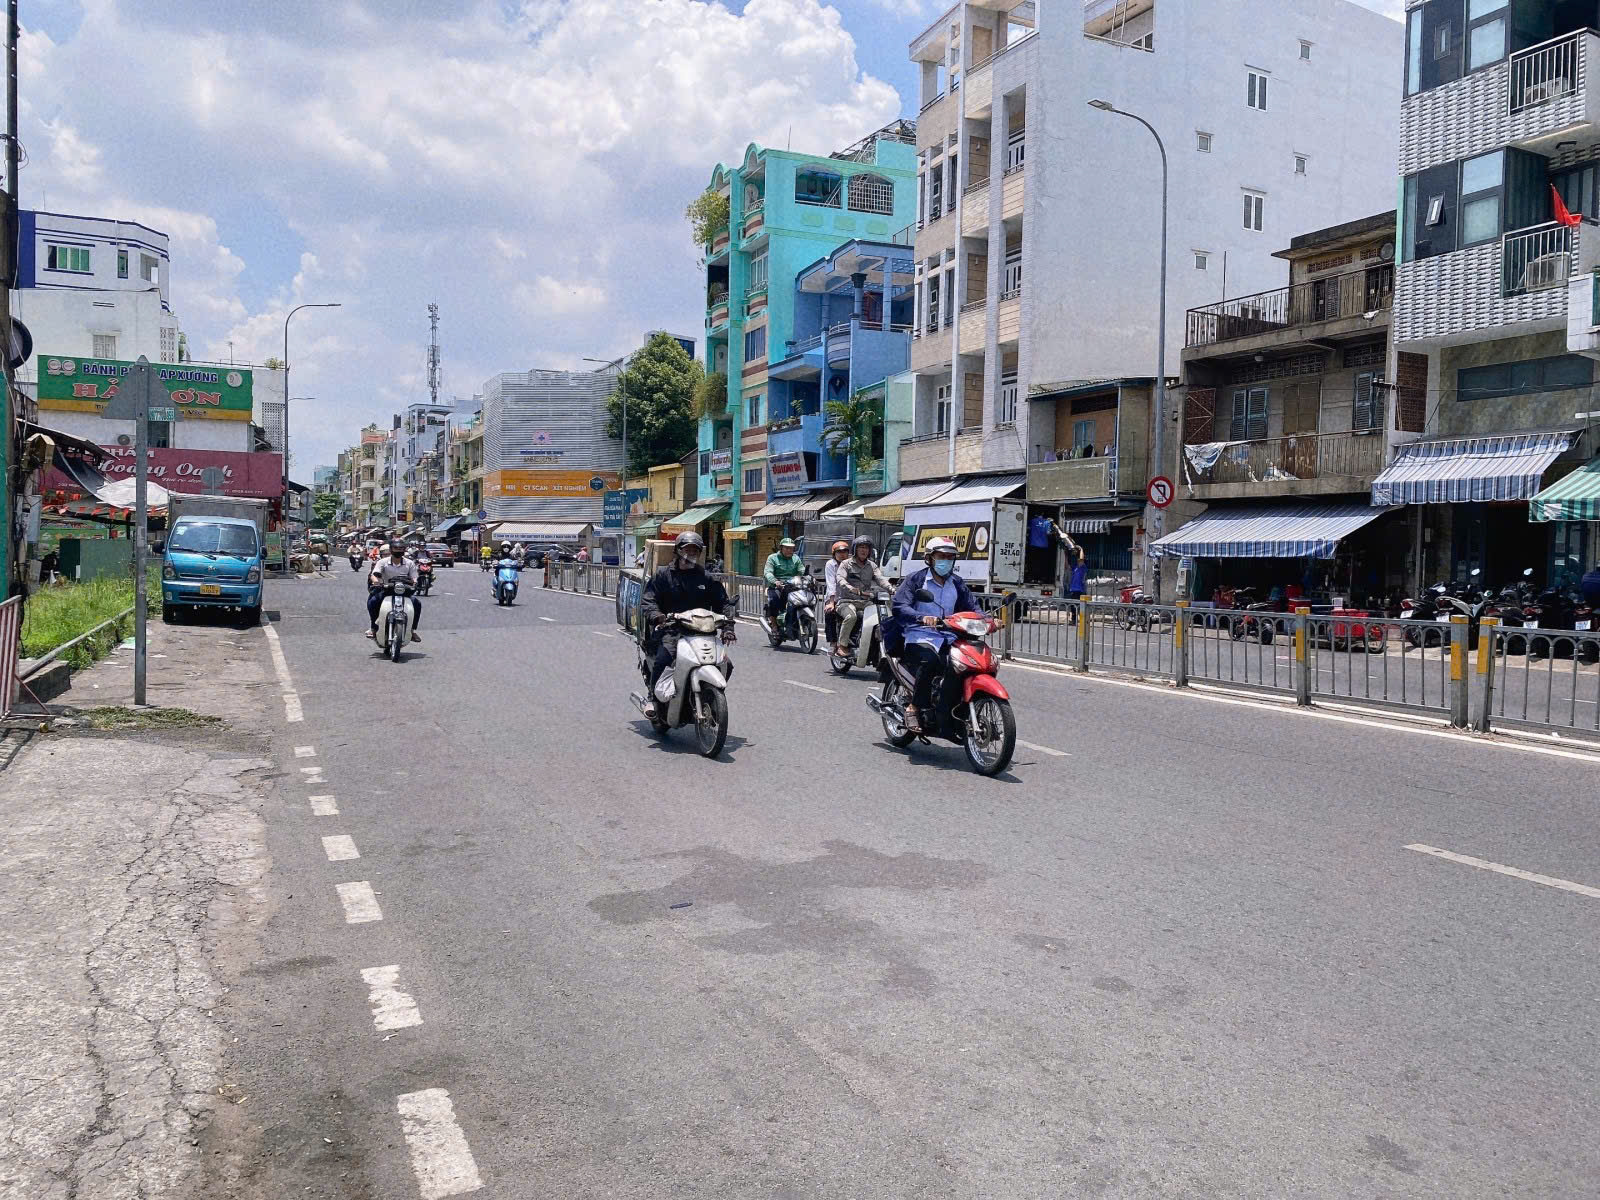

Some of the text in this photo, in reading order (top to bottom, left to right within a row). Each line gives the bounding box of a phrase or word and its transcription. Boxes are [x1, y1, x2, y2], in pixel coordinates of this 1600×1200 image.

[82, 362, 117, 376] BÁNH
[72, 378, 221, 405] HẢ ƠN
[175, 462, 233, 478] Oah
